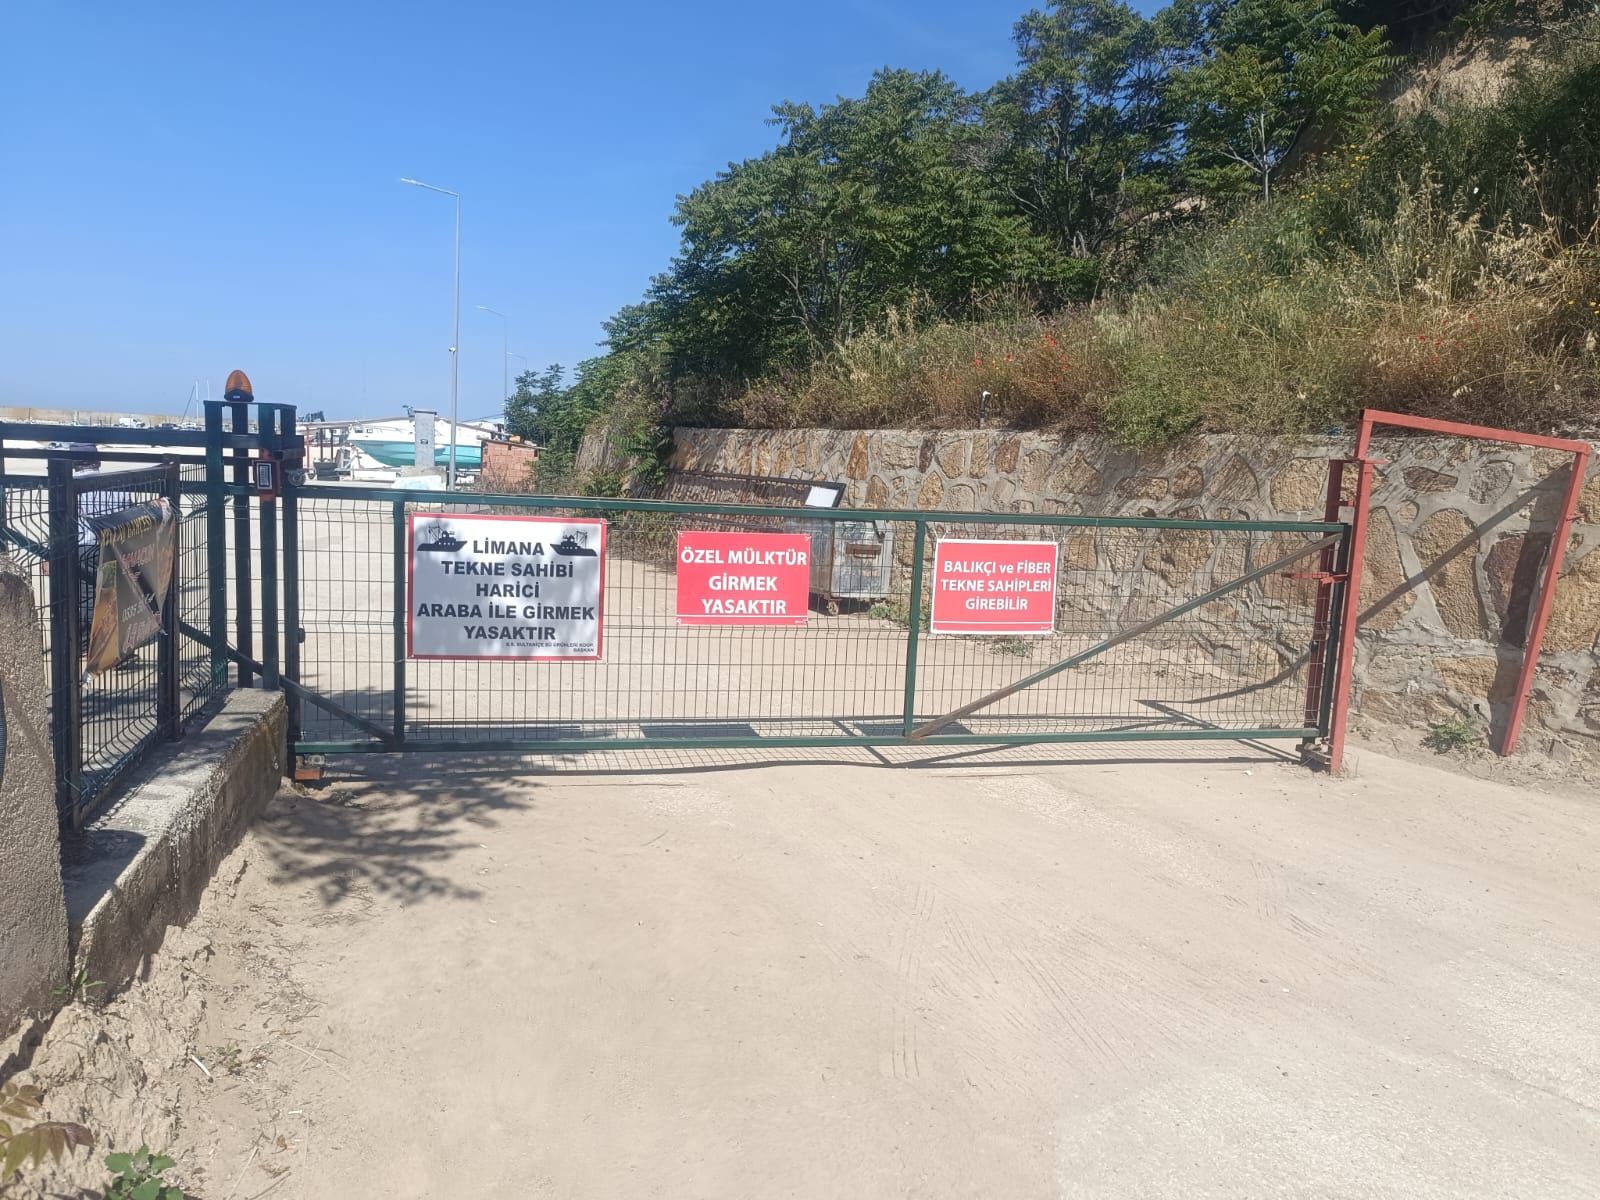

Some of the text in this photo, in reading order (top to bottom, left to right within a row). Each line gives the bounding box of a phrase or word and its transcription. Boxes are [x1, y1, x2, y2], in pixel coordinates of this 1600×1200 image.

[473, 537, 545, 556] LİMANA
[680, 546, 807, 566] ÖZEL MÜLKTÜR
[441, 561, 574, 578] TEKNE SAHİBİ
[943, 559, 1051, 576] BALIKÇI ve FİBER
[476, 581, 540, 598] HARİCİ
[708, 572, 778, 591] GİRMEK
[940, 577, 1051, 593] TEKNE SAHİPLERİ
[417, 601, 595, 620] ARABA İLE GİRMEK
[701, 598, 787, 614] YASAKTIR
[965, 595, 1028, 611] GİREBİLİR
[464, 626, 556, 641] YASAKTIR
